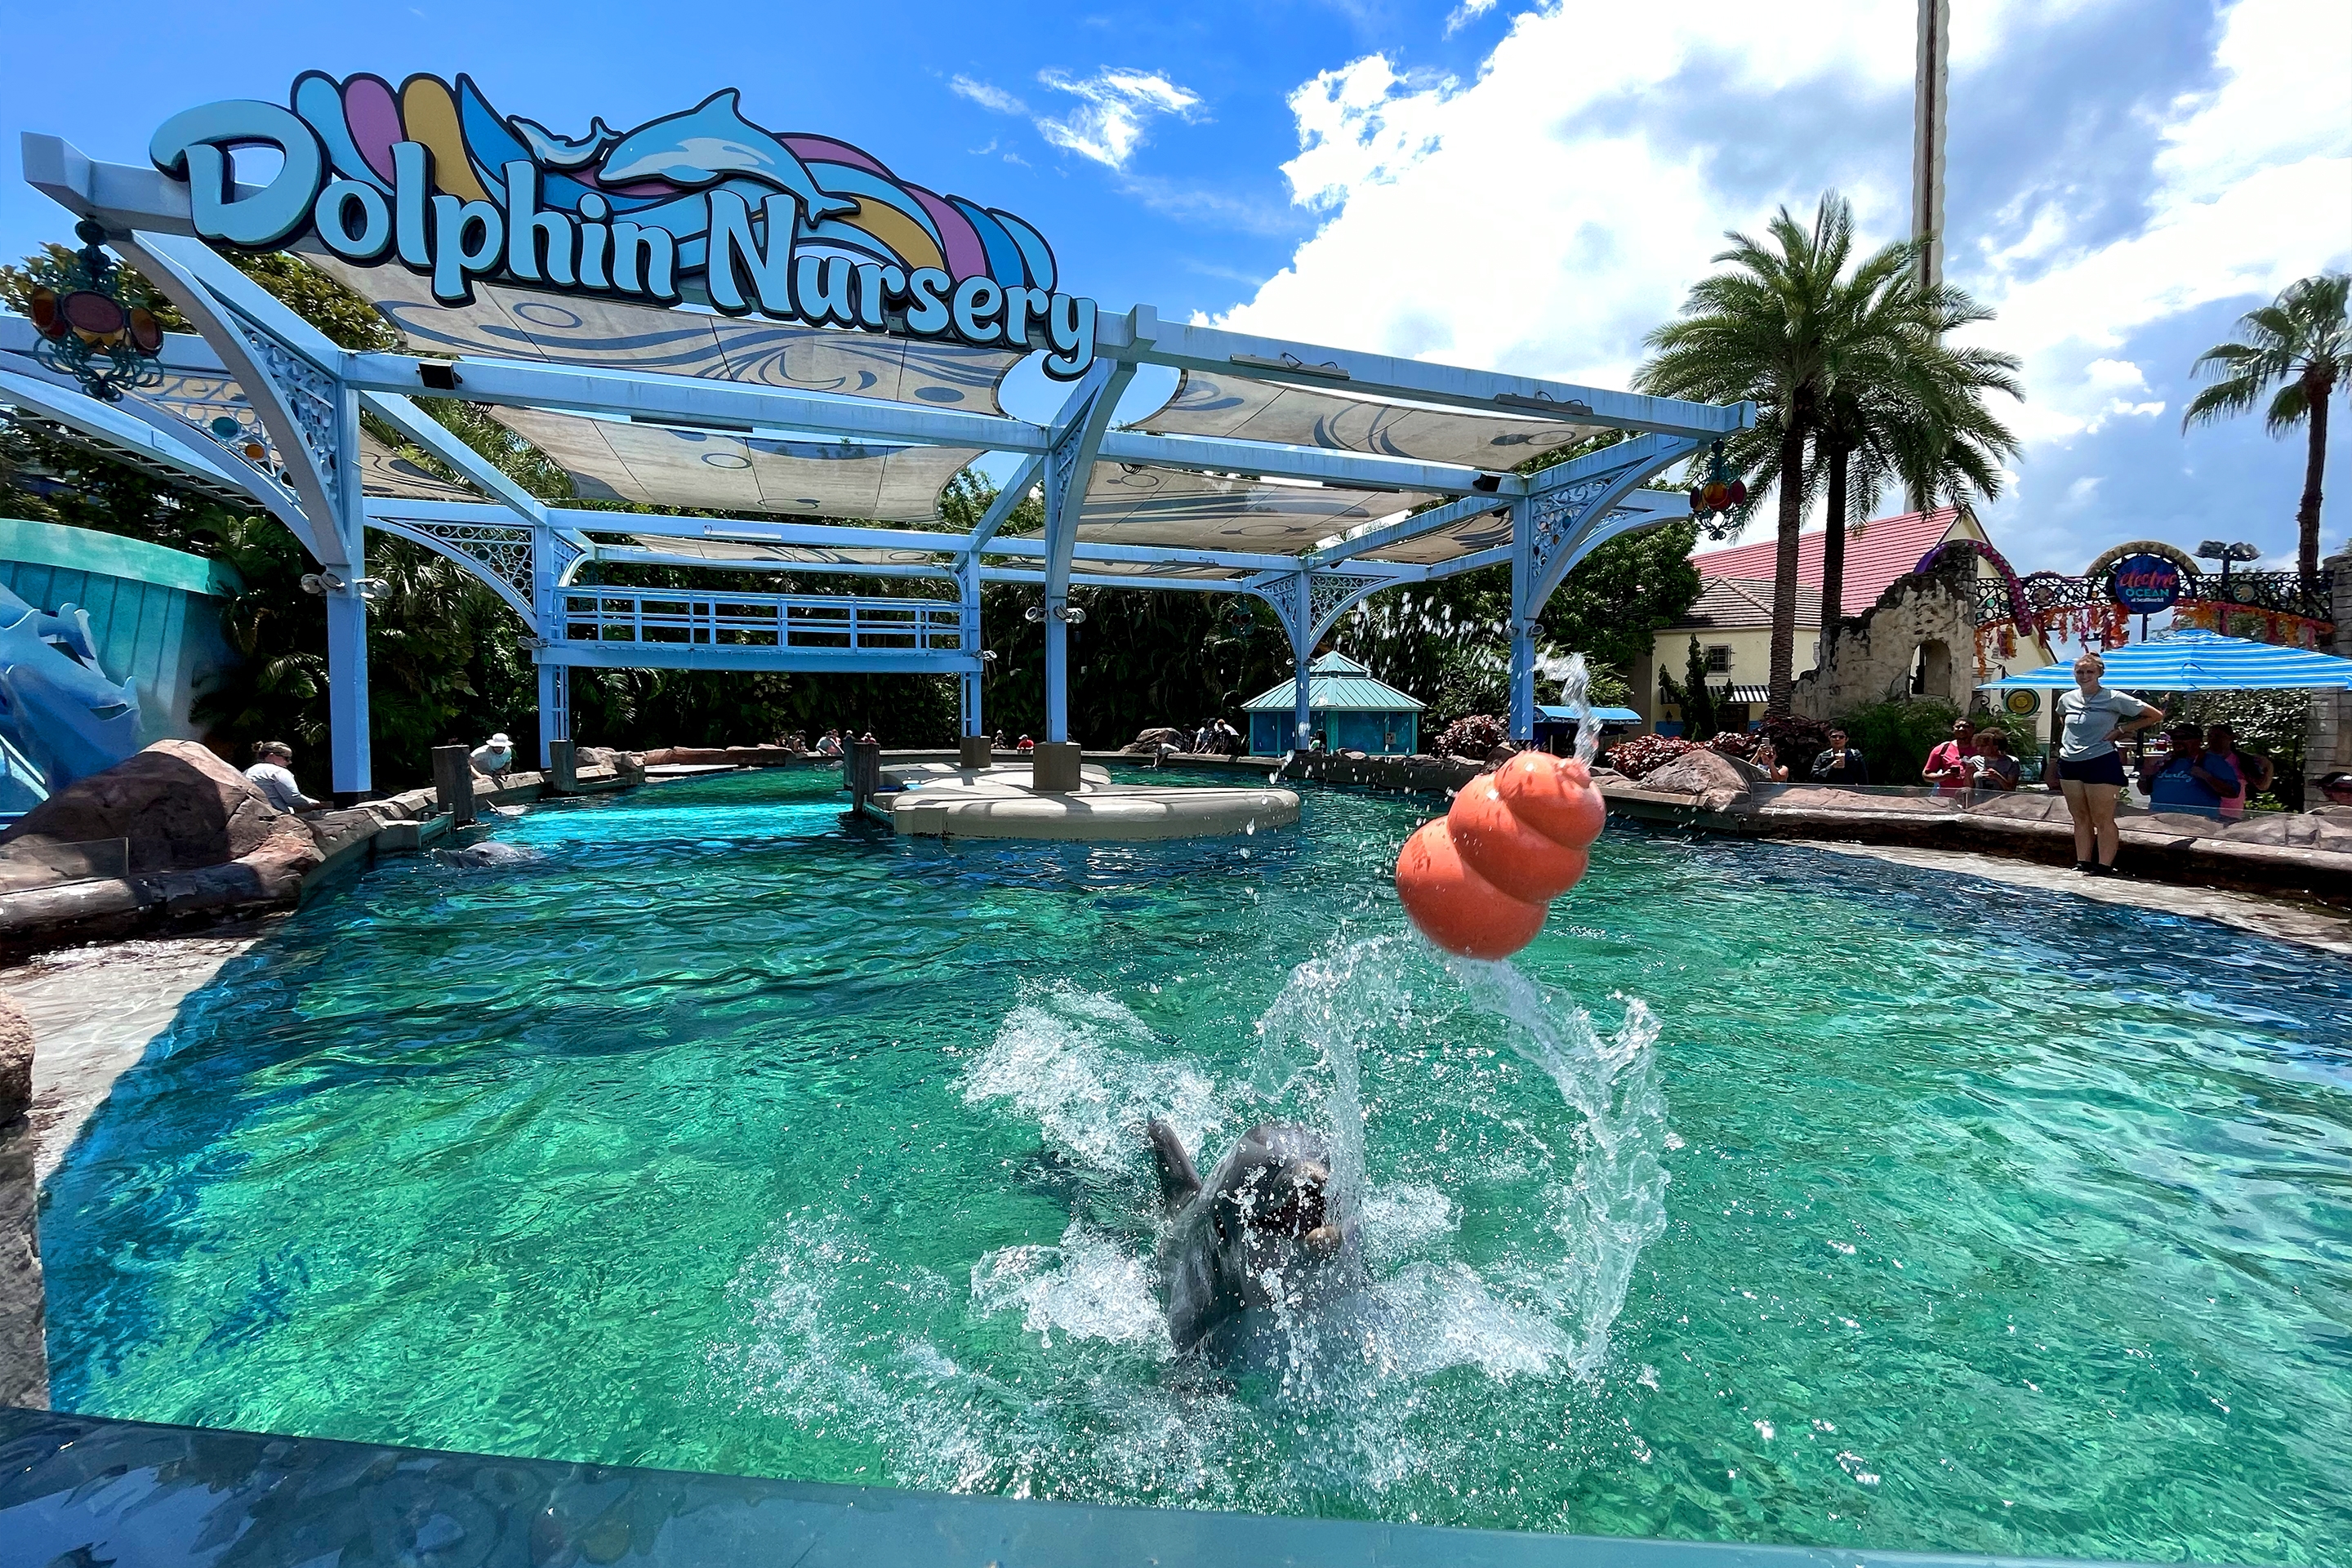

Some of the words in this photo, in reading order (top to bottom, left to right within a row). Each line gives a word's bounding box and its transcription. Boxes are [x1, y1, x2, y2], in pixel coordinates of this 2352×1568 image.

[149, 99, 678, 306] Dolphin
[708, 189, 1098, 381] Nursery
[2125, 588, 2170, 597] OCEAN
